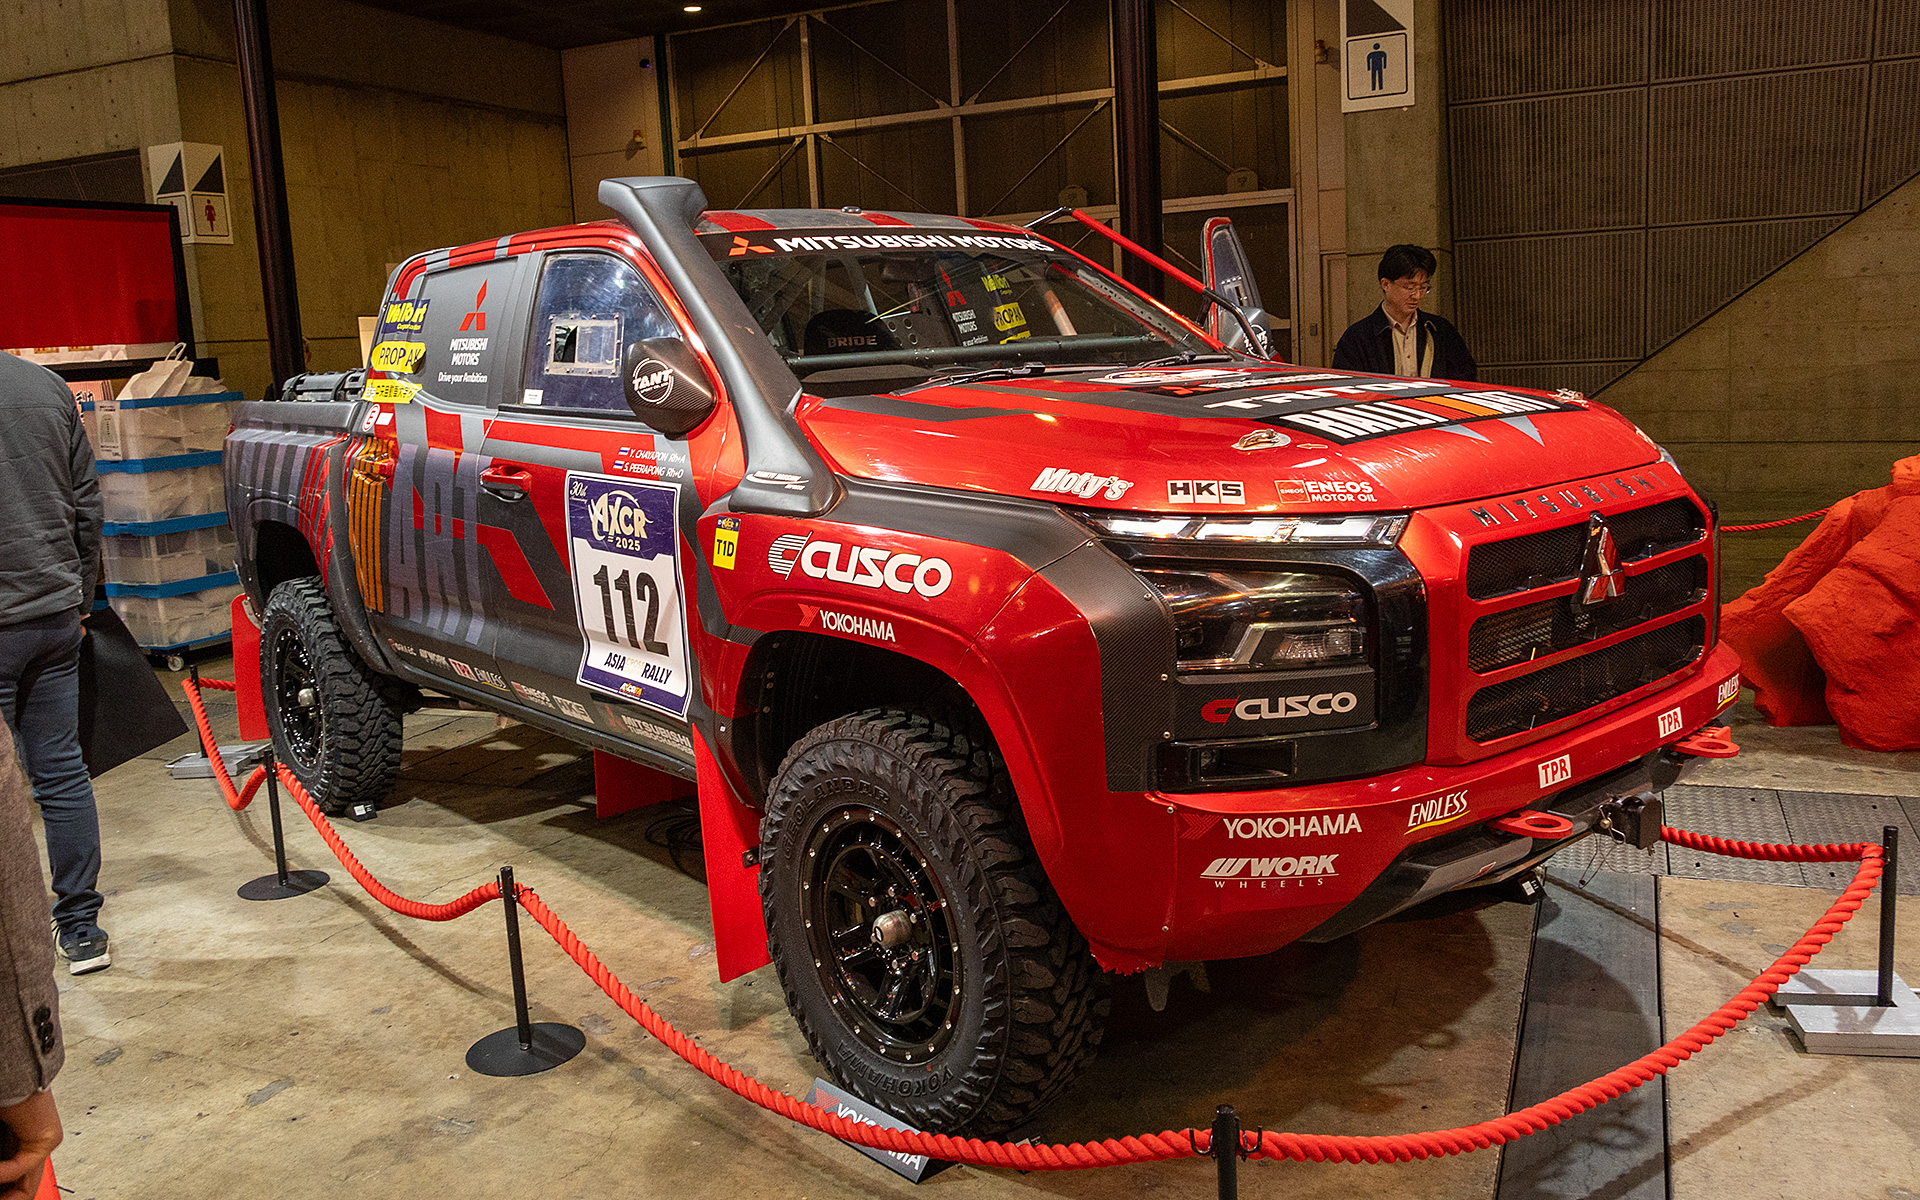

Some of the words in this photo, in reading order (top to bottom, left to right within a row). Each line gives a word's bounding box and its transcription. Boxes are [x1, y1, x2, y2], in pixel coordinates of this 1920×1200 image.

[773, 235, 949, 251] MITSUBISHI
[949, 236, 1055, 251] MOTORS
[449, 338, 489, 351] MITSUBISHI
[827, 335, 877, 348] BRIDE
[451, 352, 480, 366] MOTORS
[437, 372, 451, 383] Drive
[451, 374, 463, 385] your
[462, 372, 488, 383] Ambition
[632, 368, 674, 392] TANT
[1203, 380, 1452, 410] TRITON
[1030, 467, 1130, 501] Moty's
[1169, 481, 1243, 497] HKS
[1305, 481, 1373, 494] ENEOS
[1311, 493, 1356, 502] MOTOR
[1356, 494, 1378, 502] OIL
[1468, 470, 1667, 527] MITSUBISHI
[615, 536, 641, 552] 2025
[716, 538, 735, 558] T1D
[800, 540, 952, 598] CUSCO
[593, 564, 670, 658] 112
[820, 609, 896, 642] YOKOHAMA
[604, 652, 627, 671] ASIA
[641, 662, 673, 684] RALLY
[1235, 691, 1358, 721] CUSCO
[621, 714, 692, 748] MITSUBISHI
[1660, 710, 1681, 735] TPR
[1541, 758, 1569, 785] TPR
[1407, 789, 1468, 828] ENDLESS
[1223, 812, 1363, 839] YOKOHAMA
[1249, 854, 1340, 877] WORK
[1214, 877, 1324, 889] WHEELS
